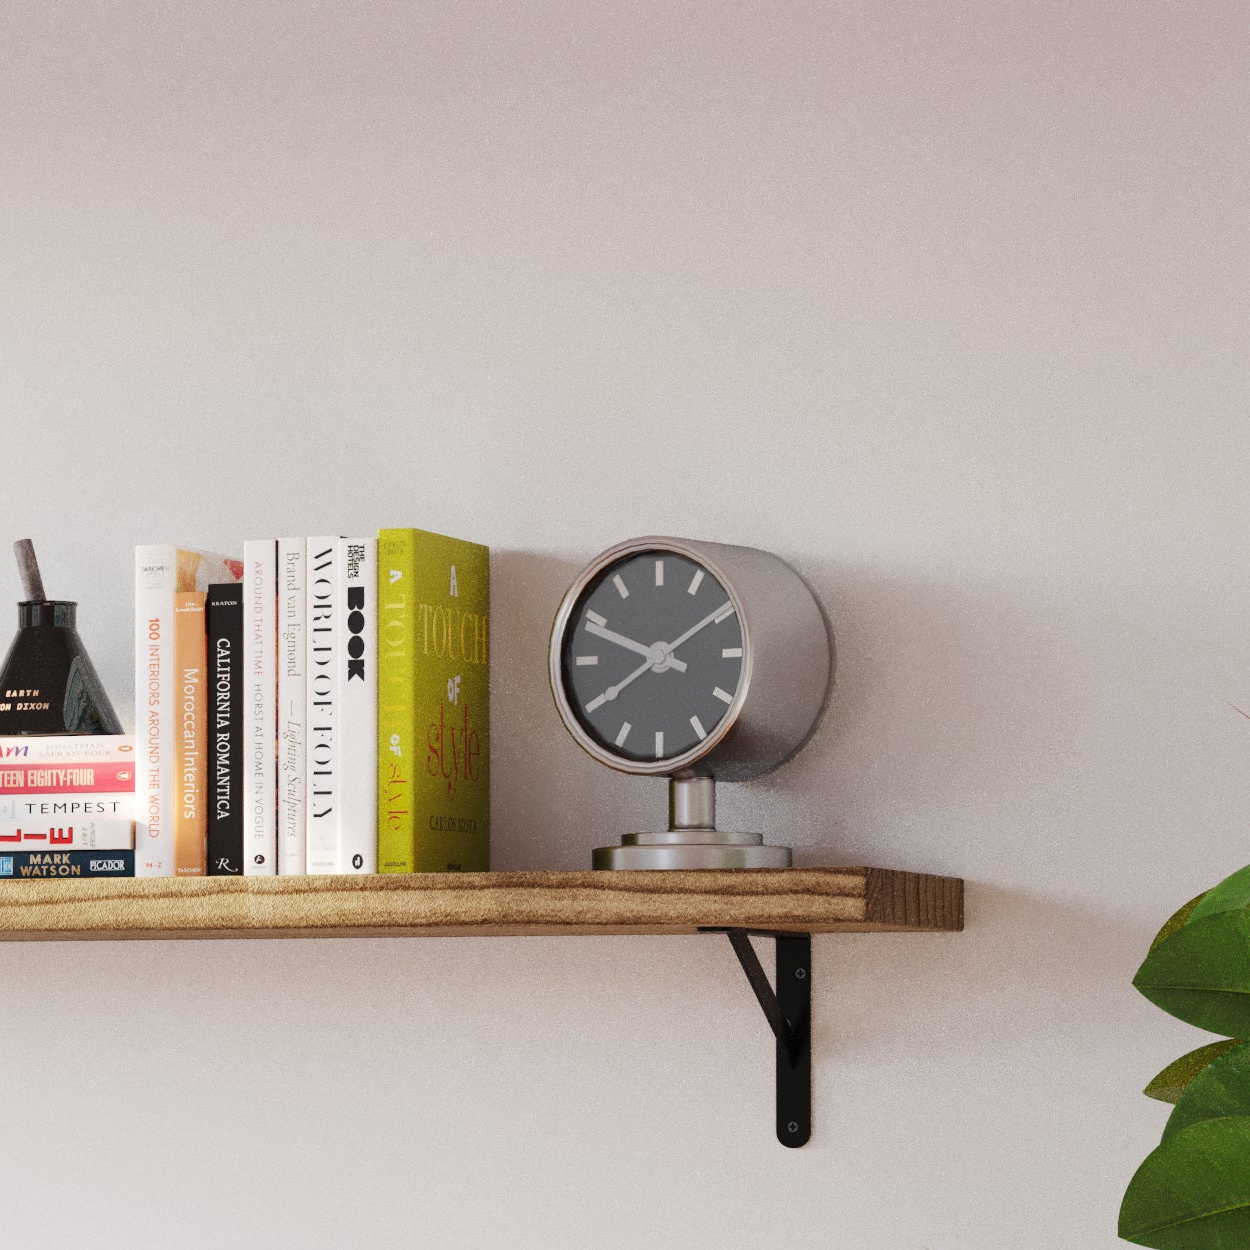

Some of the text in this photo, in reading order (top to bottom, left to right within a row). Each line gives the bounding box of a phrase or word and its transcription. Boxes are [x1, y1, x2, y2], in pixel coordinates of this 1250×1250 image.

[389, 569, 403, 585] A
[450, 565, 459, 598] A
[254, 561, 263, 676] AROUND THAT TIME
[283, 552, 301, 677] Brand van Egmond
[347, 586, 365, 682] BOOK
[419, 604, 488, 665] TOUCH
[5, 689, 40, 698] EARTH
[16, 702, 50, 711] DIXON
[313, 548, 333, 818] WORLD OF FOLLY
[447, 674, 461, 706] OF
[148, 618, 160, 838] 100 INTERIORS AROUND THE WORLD
[183, 668, 199, 819] Moroccan Interiors
[216, 638, 231, 821] CALIFORNIA ROMANTICA
[283, 721, 301, 774] Lighting
[389, 733, 402, 758] OF
[427, 702, 481, 802] style
[27, 768, 95, 788] EIGHTY-FOUR
[254, 684, 264, 839] HORST AT HOME IN VOGUE
[24, 801, 121, 814] TEMPEST
[283, 775, 301, 838] Sculptures
[382, 763, 408, 831] style
[20, 864, 81, 876] WATSON
[29, 853, 71, 865] MARK
[90, 860, 125, 872] PICADOR
